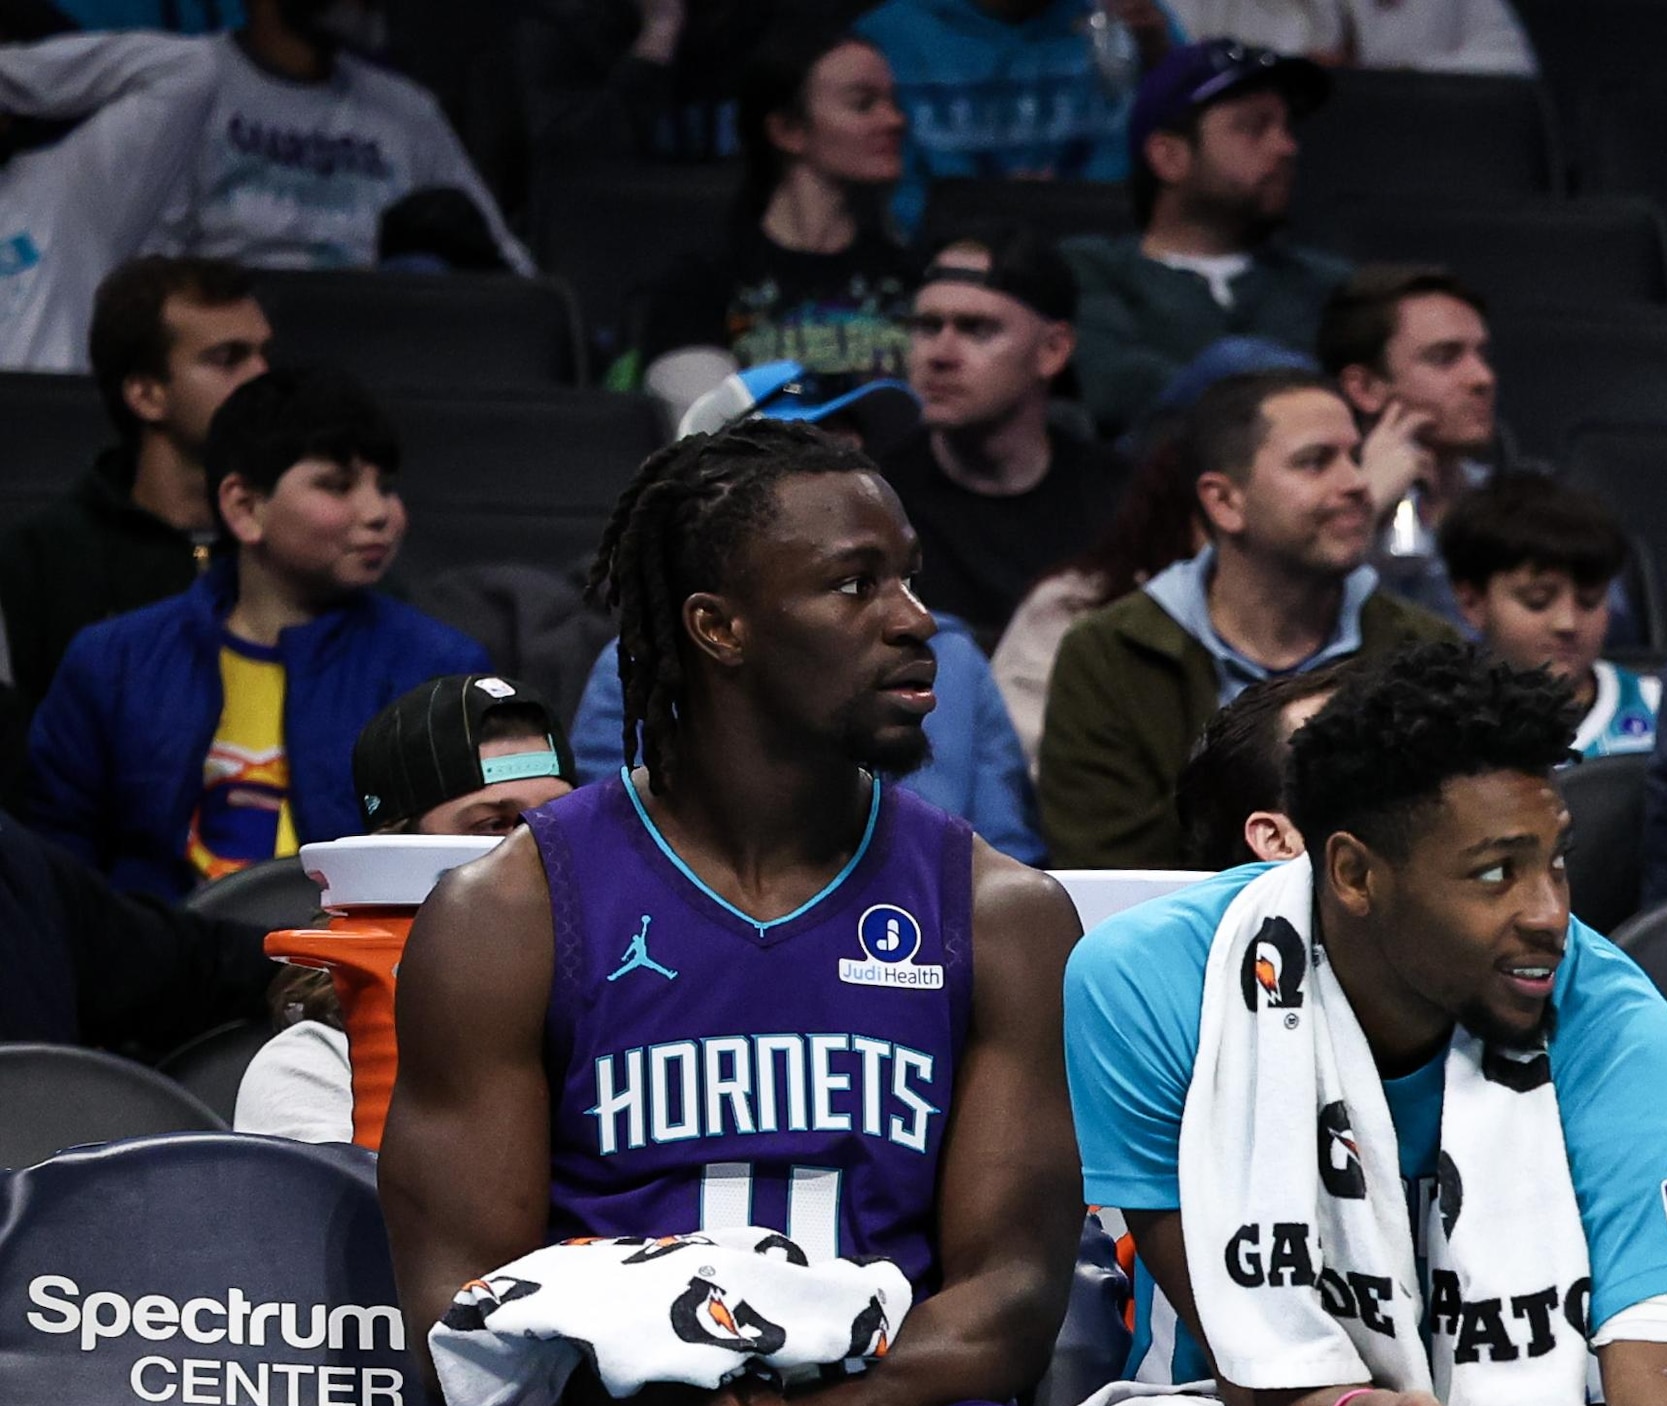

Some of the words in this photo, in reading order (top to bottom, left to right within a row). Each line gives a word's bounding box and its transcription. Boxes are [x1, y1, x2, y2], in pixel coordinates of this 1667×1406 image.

[843, 963, 881, 981] Judi
[885, 967, 940, 985] Health
[583, 1033, 941, 1156] HORNETS
[27, 1275, 405, 1351] Spectrum
